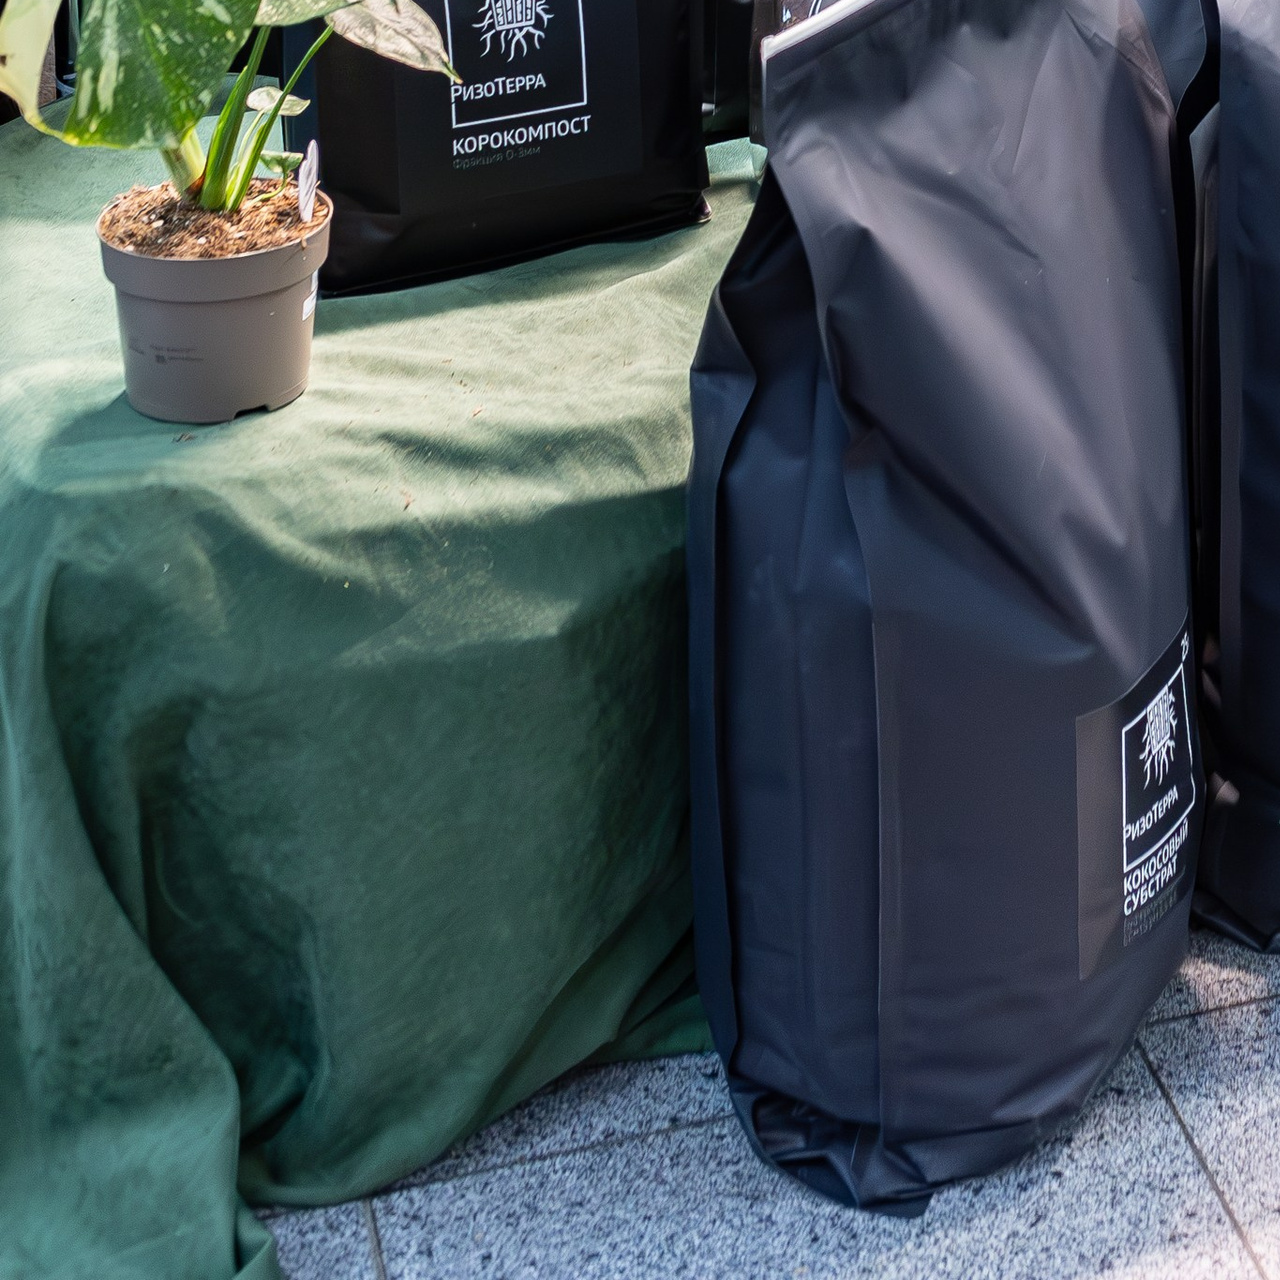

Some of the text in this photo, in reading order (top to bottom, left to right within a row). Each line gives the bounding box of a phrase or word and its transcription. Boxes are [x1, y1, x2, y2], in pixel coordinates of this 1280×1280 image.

[452, 114, 592, 156] КОРОКОМПОСТ
[1123, 816, 1190, 897] КОКОСОВЫЙ
[1123, 854, 1178, 917] СУБСТРАТ
